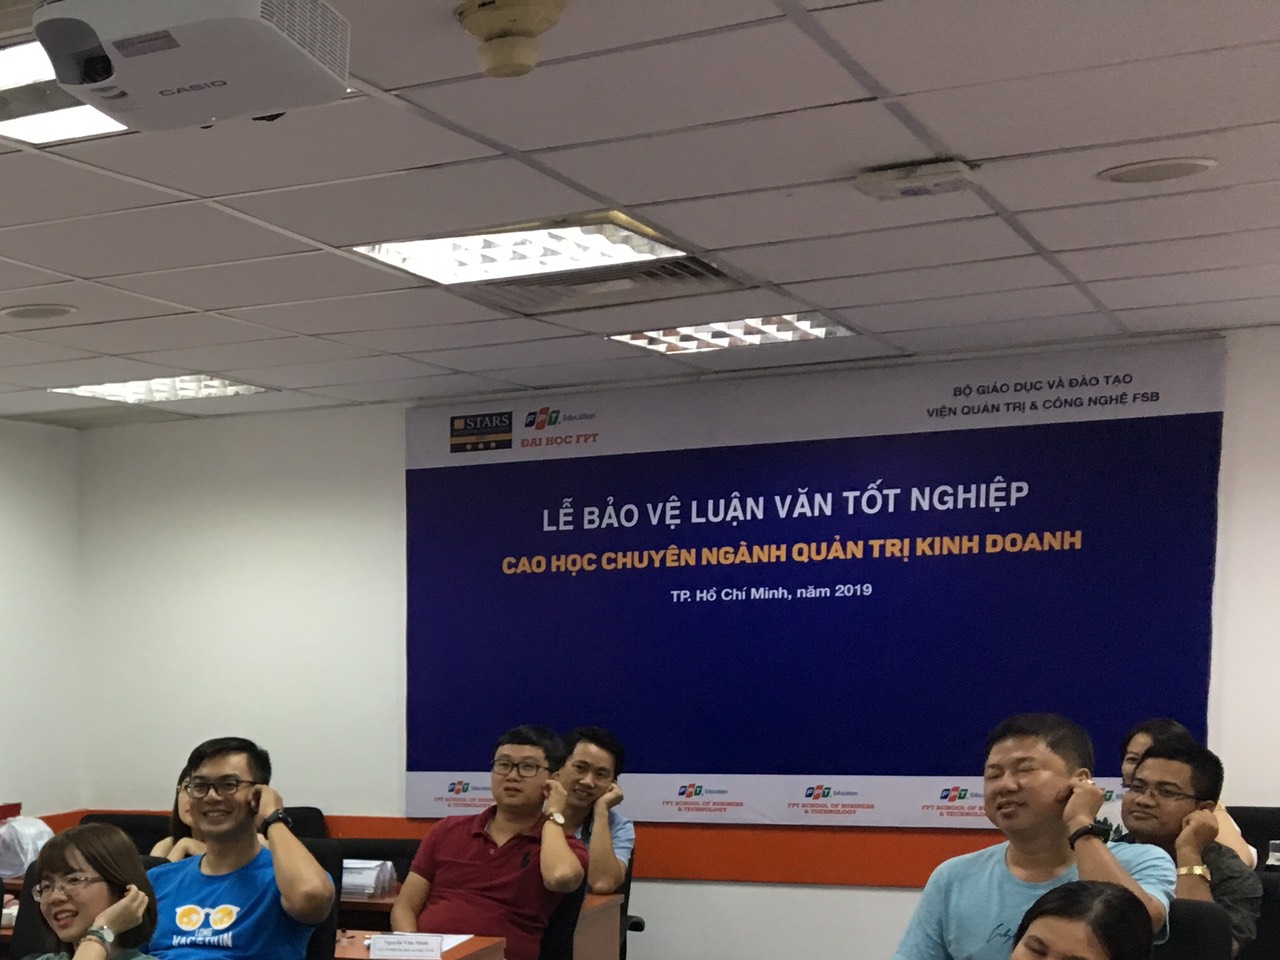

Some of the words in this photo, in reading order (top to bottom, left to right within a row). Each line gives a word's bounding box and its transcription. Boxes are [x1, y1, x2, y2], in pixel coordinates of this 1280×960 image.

[159, 80, 228, 96] CASIO
[953, 384, 972, 397] BỘ
[977, 381, 1010, 395] GIÁO
[1013, 380, 1043, 394] DỤC
[1047, 376, 1065, 389] VÀ
[1069, 375, 1099, 388] ĐÀO
[1104, 373, 1133, 387] TẠO
[927, 405, 957, 418] VIỆN
[961, 400, 1000, 416] QUẢN
[1004, 401, 1026, 414] TRỊ
[1029, 401, 1039, 410] &
[1043, 396, 1084, 409] CÔNG
[1087, 392, 1128, 407] NGHỆ
[1133, 391, 1160, 404] FSB
[467, 415, 509, 429] STARS
[524, 407, 561, 430] FPT
[576, 433, 599, 443] FPT
[543, 497, 574, 531] LỄ
[583, 496, 639, 530] BẢO
[647, 495, 682, 529] VỆ
[691, 491, 764, 526] LUẬN
[774, 487, 832, 519] VĂN
[842, 479, 901, 515] TỐT
[910, 475, 1029, 512] NGHIỆP
[502, 555, 546, 574] CAO
[551, 552, 597, 576] HỌC
[601, 544, 696, 571] CHUYÊN
[701, 541, 786, 566] NGÀNH
[791, 535, 864, 563] QUẢN
[869, 537, 910, 562] TRỊ
[916, 535, 980, 556] KINH
[985, 530, 1082, 554] DOANH
[670, 590, 692, 603] TP.
[696, 586, 717, 601] Hồ
[721, 587, 746, 601] Chí
[750, 586, 792, 601] Minh,
[796, 585, 831, 598] năm
[835, 583, 873, 597] 2019
[678, 783, 703, 798] FPT
[805, 785, 832, 800] FPT
[940, 786, 969, 802] FPT
